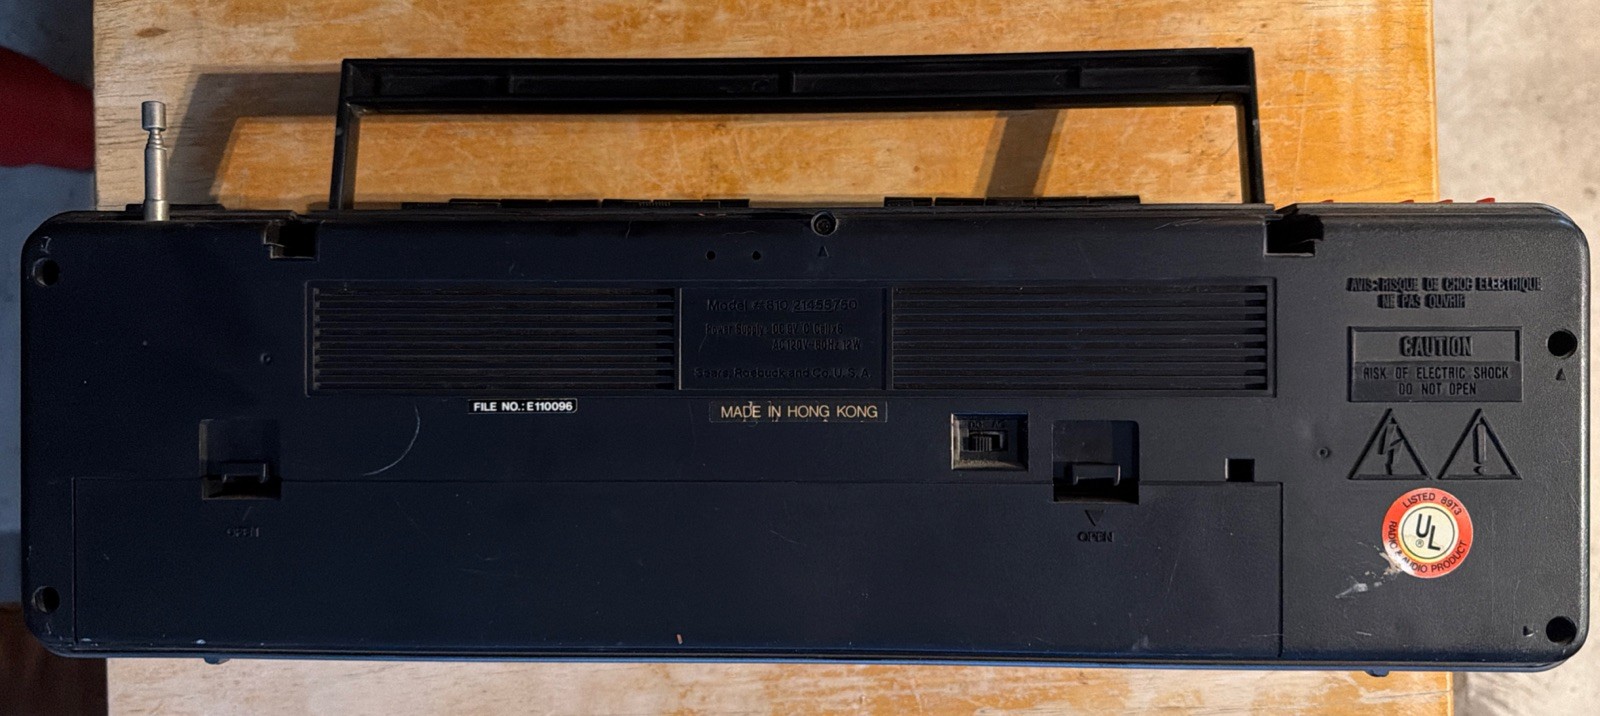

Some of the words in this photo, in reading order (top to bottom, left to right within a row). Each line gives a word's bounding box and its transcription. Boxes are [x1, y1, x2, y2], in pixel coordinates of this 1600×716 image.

[1378, 277, 1418, 292] RISQUE
[1422, 278, 1439, 291] DE
[1442, 277, 1472, 291] CHOC
[1475, 277, 1542, 292] ELECTRIQUE
[706, 299, 748, 312] Model
[1377, 294, 1395, 308] NE
[1397, 294, 1421, 308] PAS
[1424, 294, 1465, 308] OUVRIR
[705, 323, 733, 335] Power
[1400, 336, 1472, 357] CAUTION
[734, 368, 785, 378] Roebuck
[788, 368, 809, 378] and
[1363, 367, 1387, 380] RISK
[1395, 367, 1408, 380] OF
[1416, 367, 1466, 380] ELECTRIC
[1474, 366, 1509, 379] SHOCK
[1399, 383, 1412, 395] DO
[1421, 383, 1441, 395] NOT
[1450, 383, 1476, 395] OPEN
[473, 402, 497, 412] FILE
[720, 405, 761, 418] MADE
[768, 405, 782, 418] IN
[787, 405, 830, 418] HONG
[836, 405, 878, 418] KONG
[1402, 492, 1436, 508] LISTED
[1440, 496, 1462, 516] 89T3
[1077, 531, 1114, 542] OPEN
[1415, 513, 1441, 551] UL
[1388, 521, 1398, 549] RADIO
[1430, 540, 1467, 572] PRODUCT
